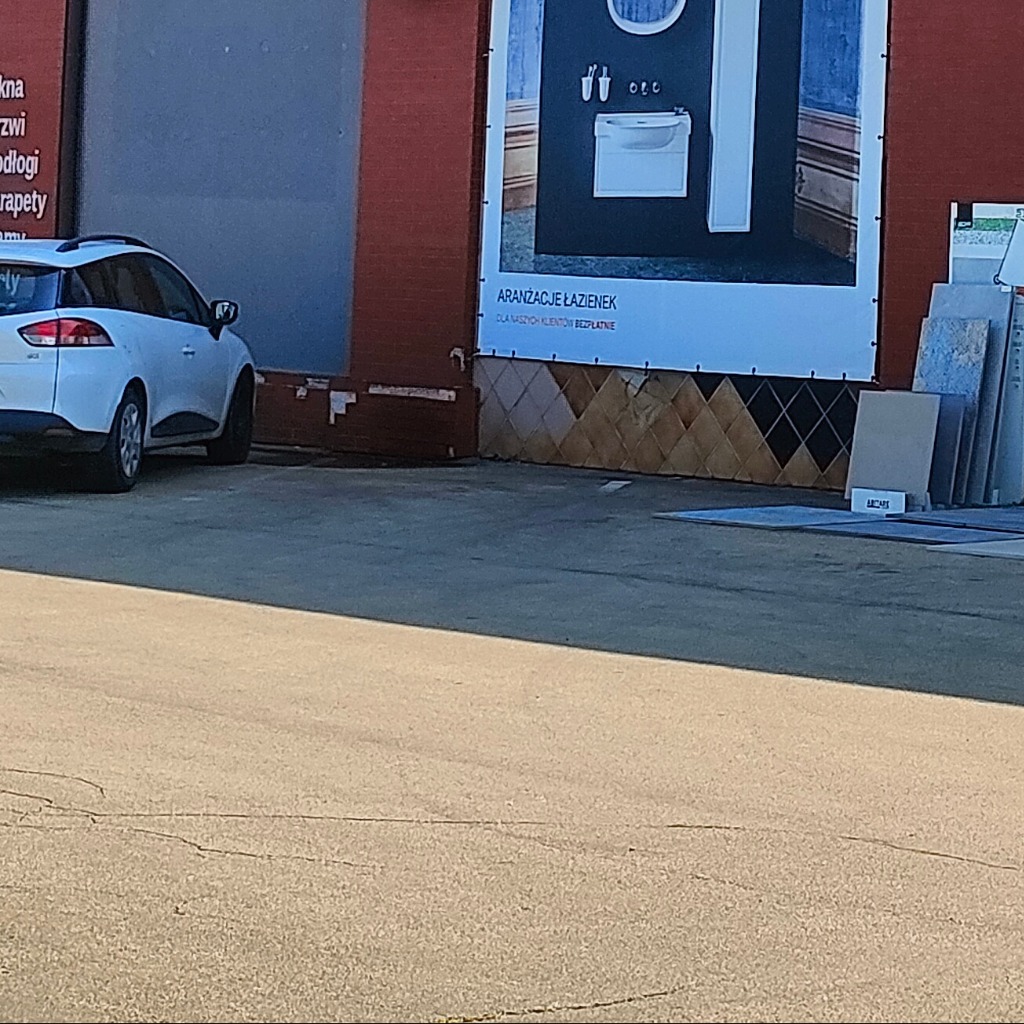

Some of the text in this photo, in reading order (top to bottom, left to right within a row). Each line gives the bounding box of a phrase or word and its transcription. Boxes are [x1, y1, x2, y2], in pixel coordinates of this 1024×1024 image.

[0, 111, 26, 136] zwi
[497, 287, 617, 310] ARANŻACJE ŁAZIENEK
